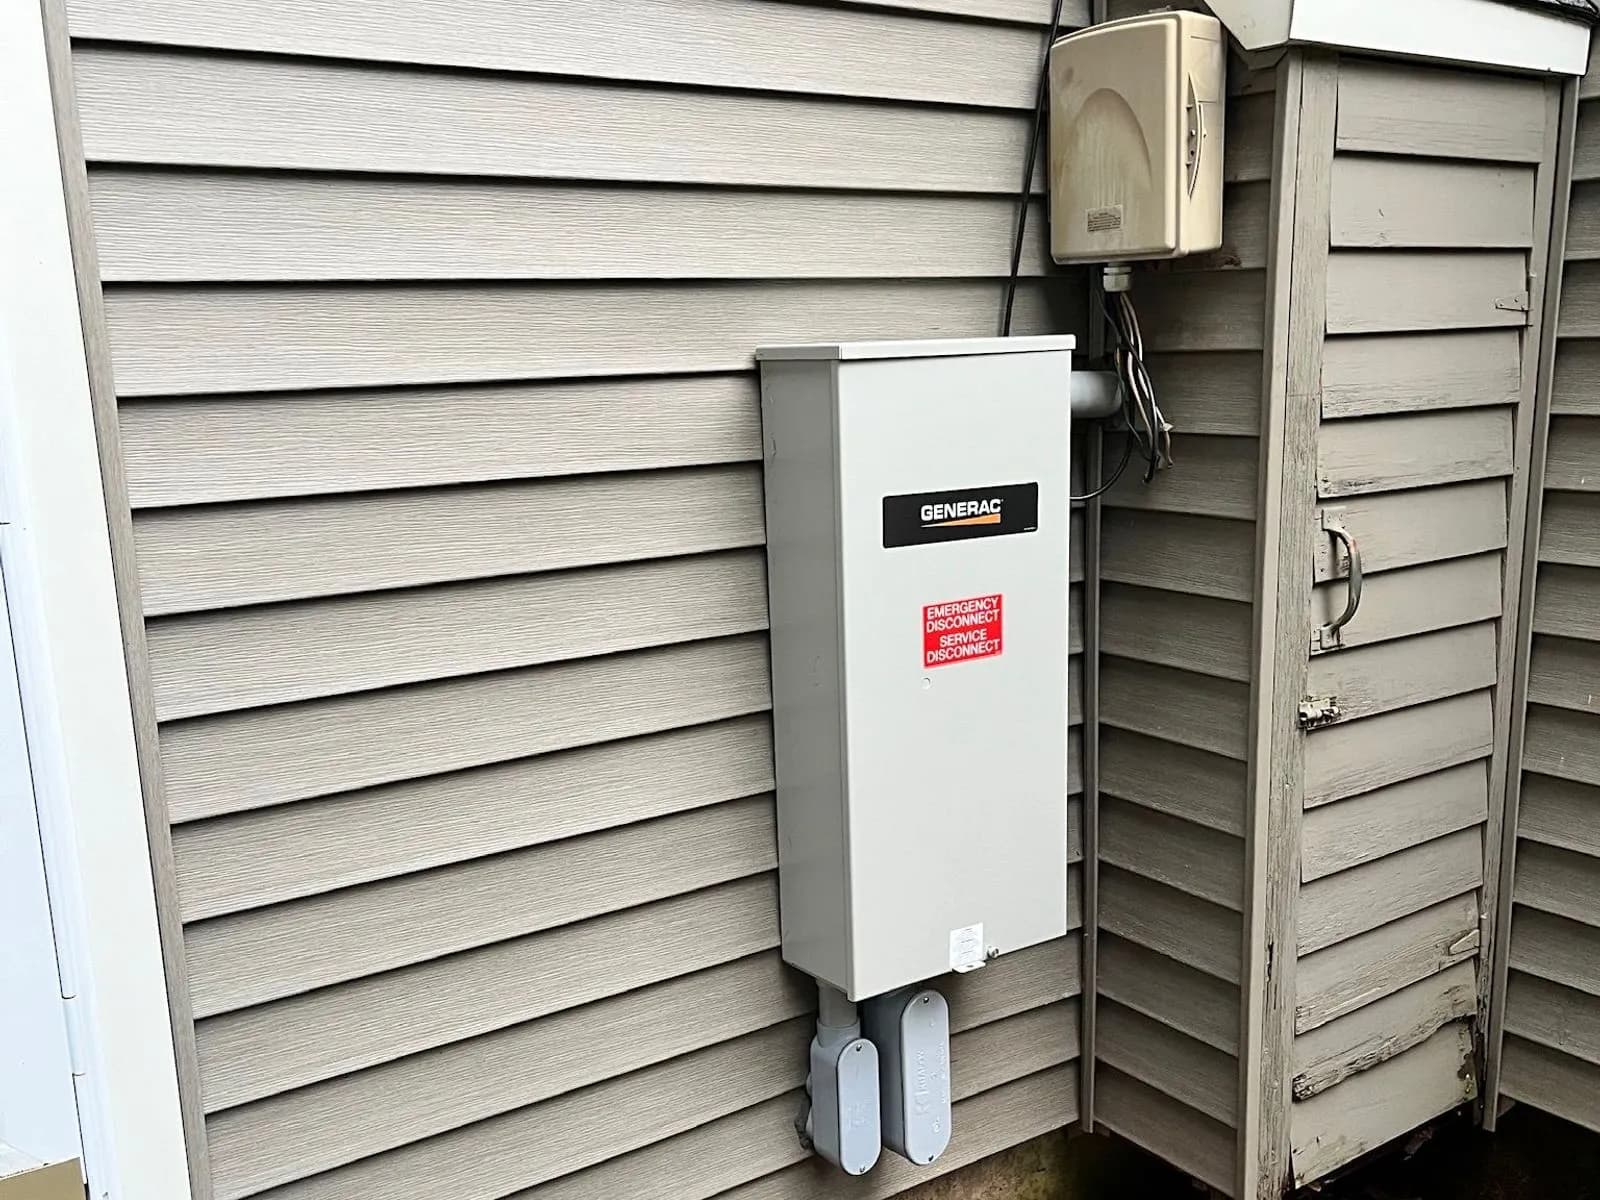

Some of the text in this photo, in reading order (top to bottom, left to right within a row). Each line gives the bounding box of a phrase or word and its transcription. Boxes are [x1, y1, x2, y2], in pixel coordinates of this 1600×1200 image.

[921, 499, 1001, 521] GENERAC
[927, 597, 999, 620] EMERGENCY
[926, 609, 1000, 633] DISCONNECT
[940, 628, 987, 647] SERVICE
[927, 639, 1000, 663] DISCONNECT
